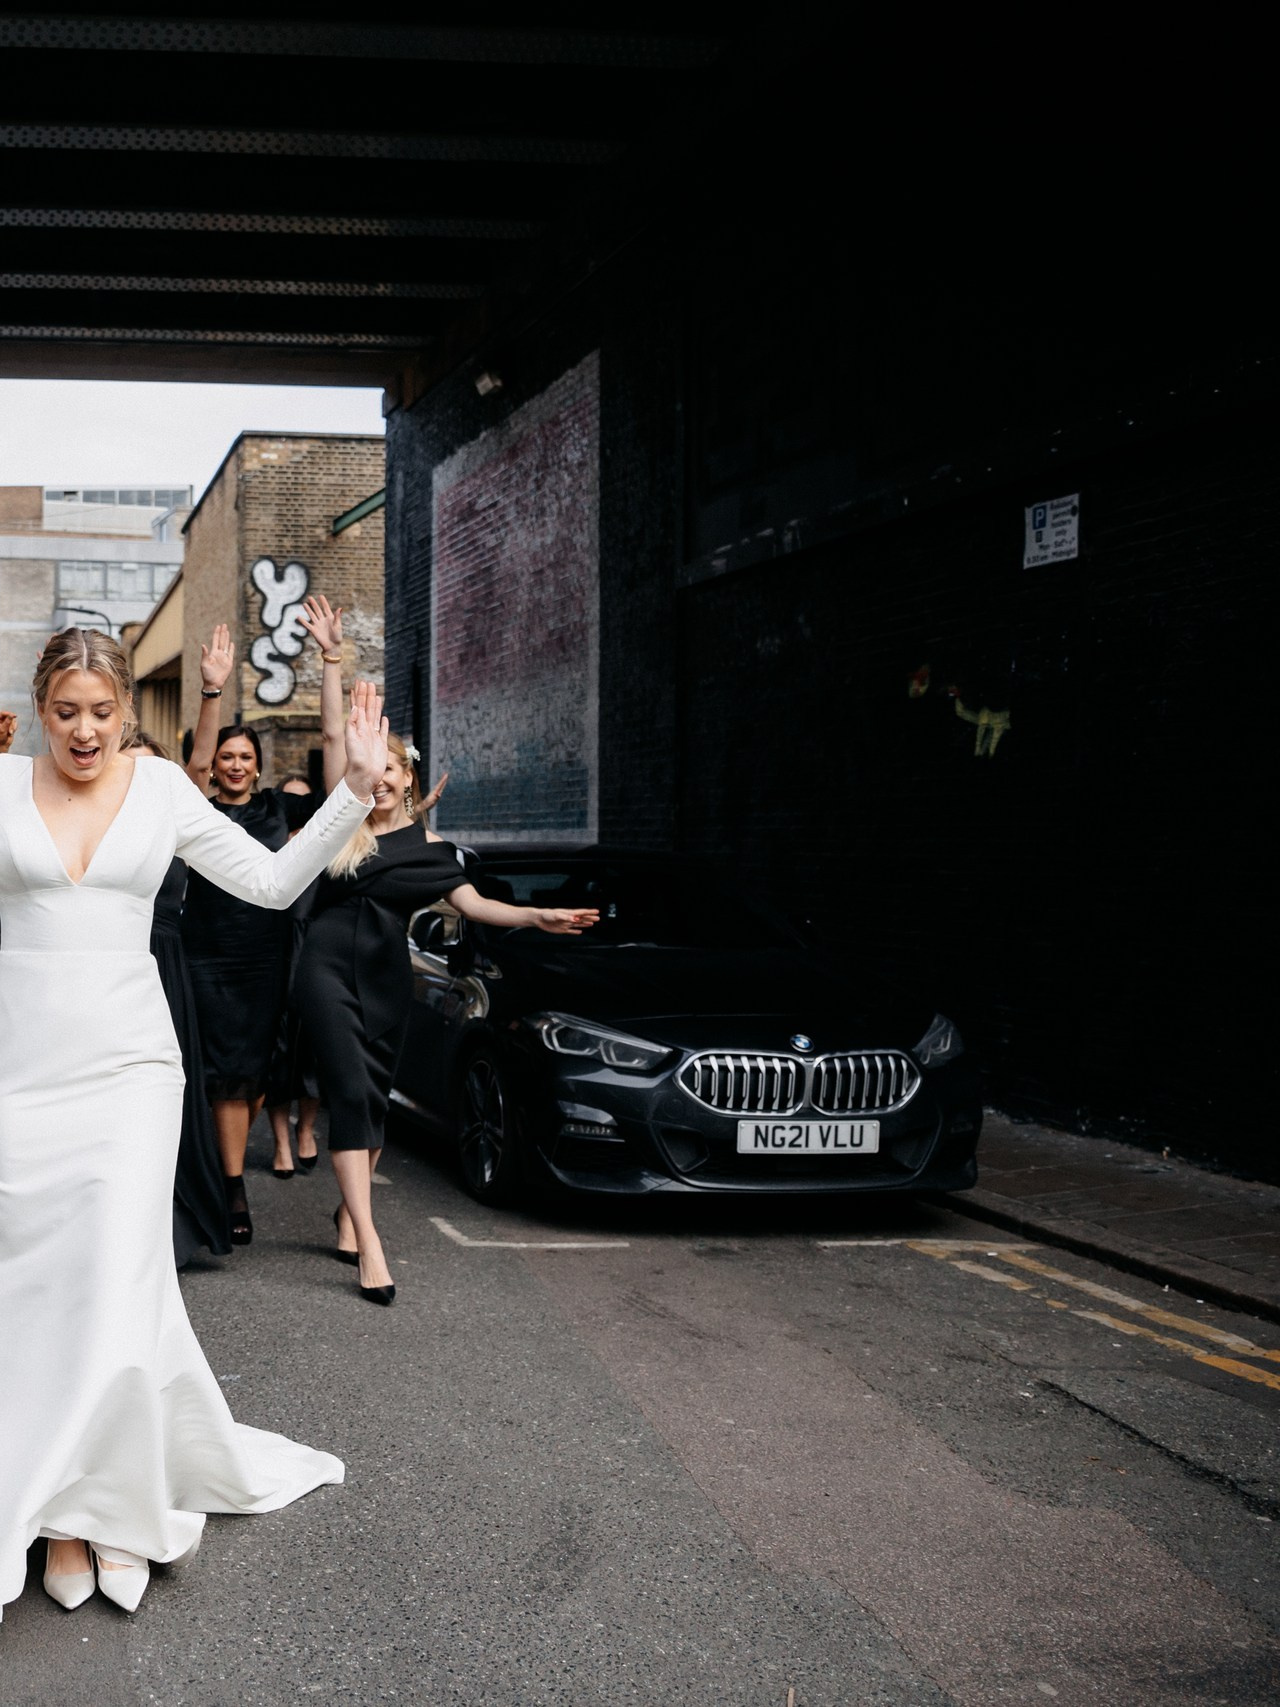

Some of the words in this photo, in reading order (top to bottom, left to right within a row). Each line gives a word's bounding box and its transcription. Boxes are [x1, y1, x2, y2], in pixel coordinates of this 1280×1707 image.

[1055, 528, 1067, 537] only
[754, 1125, 810, 1148] NG21
[819, 1125, 864, 1148] VLU
